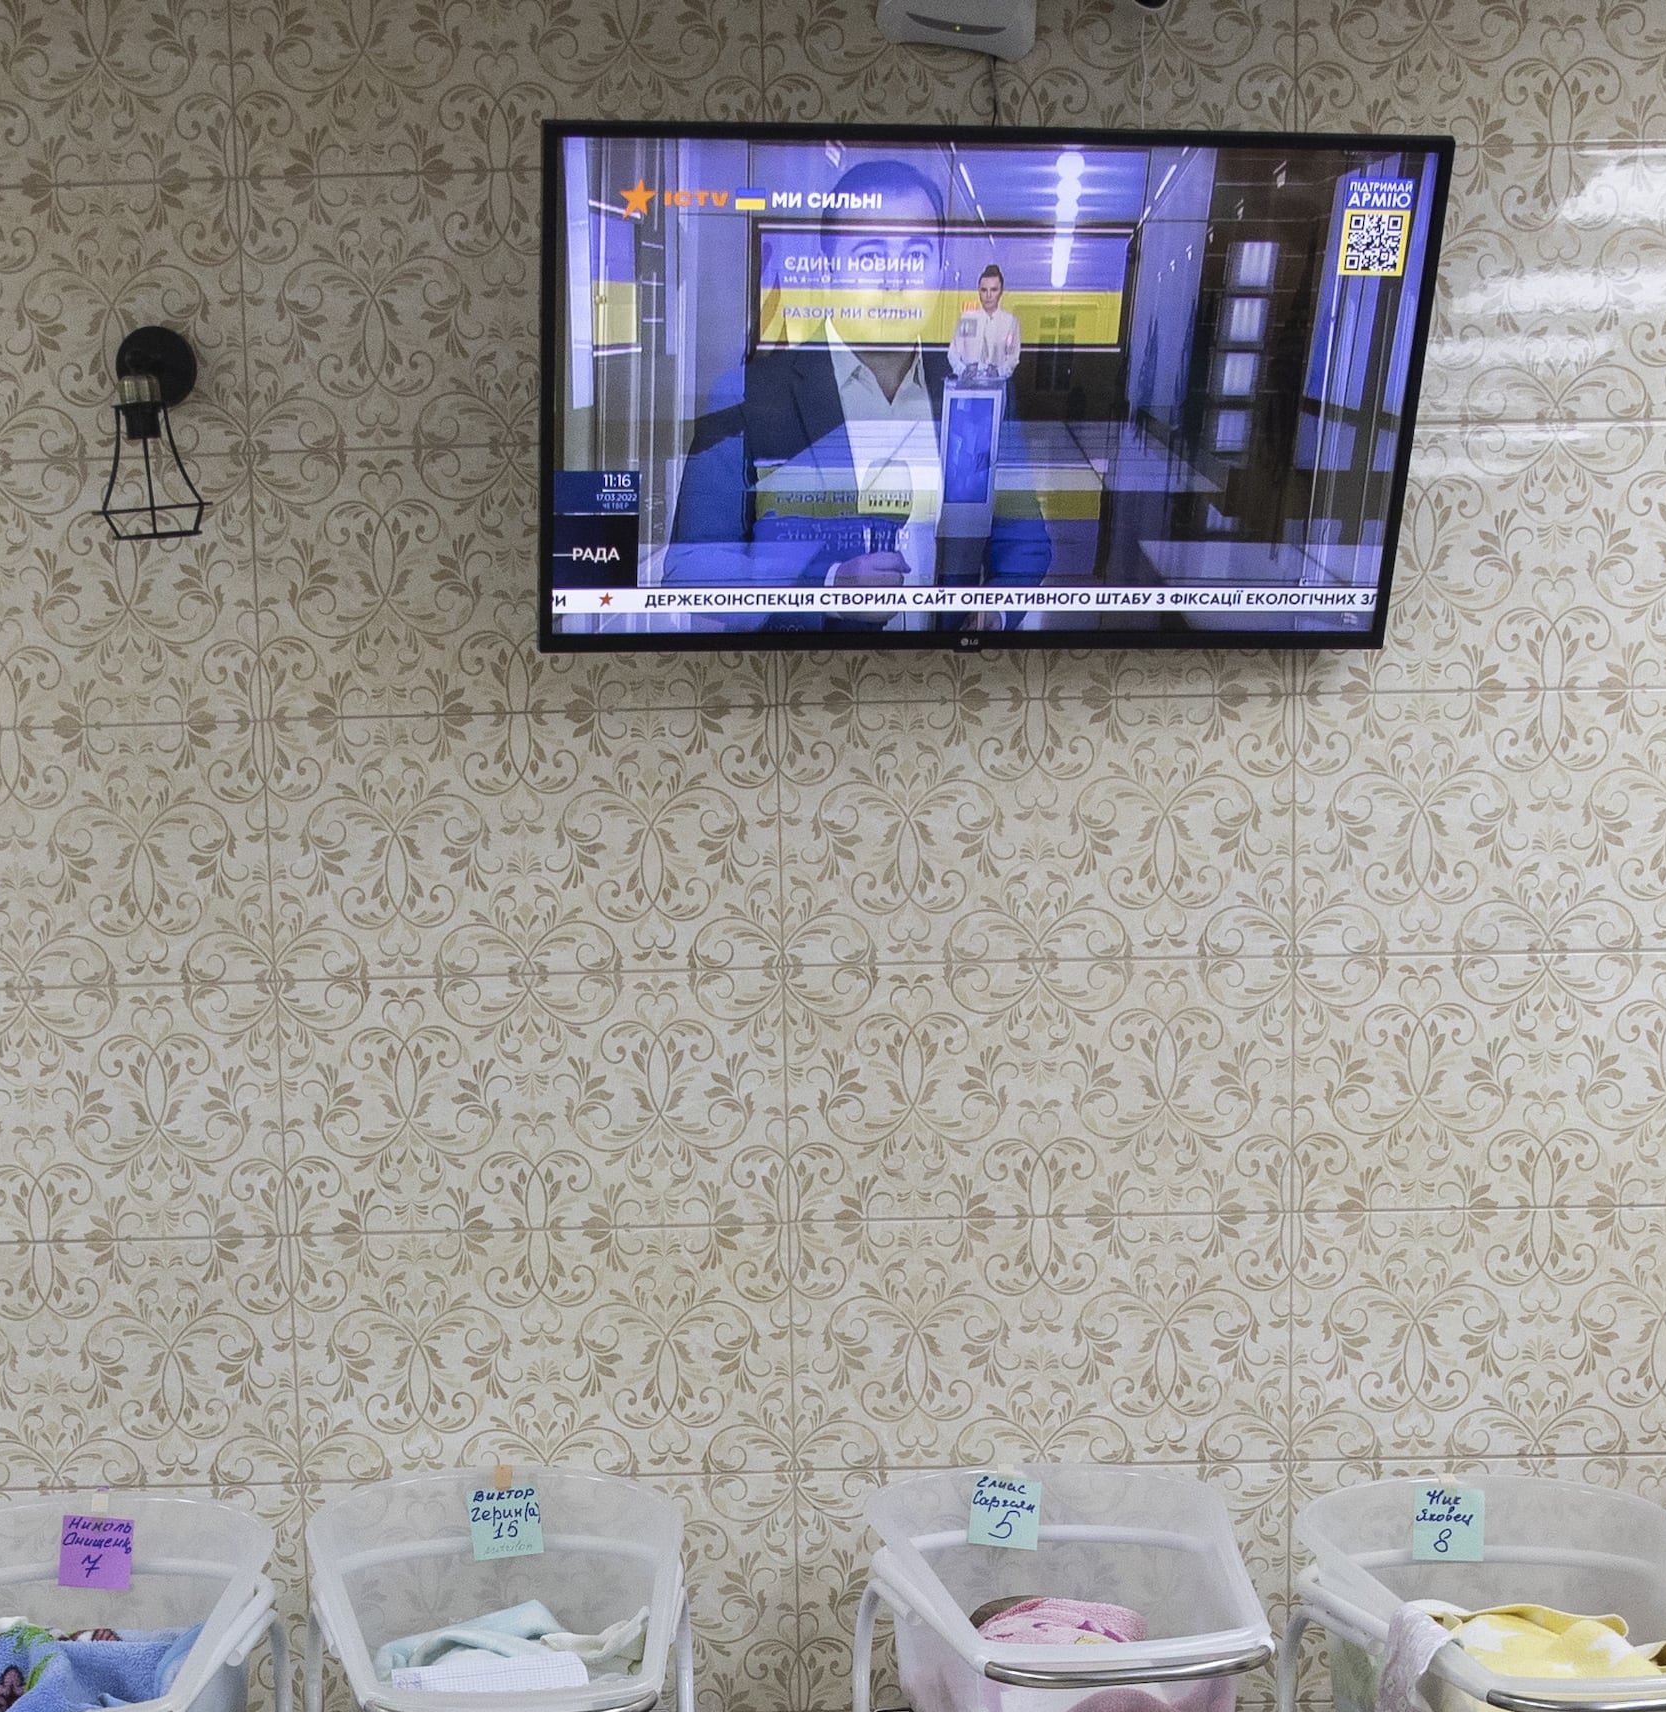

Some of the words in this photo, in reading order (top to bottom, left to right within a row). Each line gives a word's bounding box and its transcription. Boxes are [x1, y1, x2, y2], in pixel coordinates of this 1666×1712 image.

[1350, 181, 1413, 192] ПІДТРИМАЙ
[665, 191, 729, 207] ICTV
[772, 193, 802, 208] МИ
[807, 192, 883, 209] СИЛЬНІ
[1348, 192, 1411, 208] АРМІЮ
[784, 256, 841, 272] ЄДИНІ
[847, 256, 925, 272] НОВИНИ
[783, 307, 834, 318] РАЗОМ
[841, 307, 862, 319] МИ
[868, 307, 923, 319] СИЛЬНІ
[603, 474, 631, 488] 11:16
[602, 502, 629, 510] ЧЕТВЕР
[572, 547, 620, 563] РАДА
[645, 594, 814, 608] ДЕРЖЕКОІНСПЕКЦІЯ
[820, 593, 907, 606] СТВОРИЛА
[912, 589, 956, 606] САЙТ
[961, 593, 1091, 605] ОПЕРАТИВНОГО
[1095, 593, 1152, 605] ШТАБУ
[1156, 593, 1166, 605] З
[1170, 591, 1241, 607] ФІКСАЦІЇ
[1245, 593, 1356, 605] ЕКОЛОГІЧНИХ
[68, 1517, 132, 1533] Николь
[493, 1520, 519, 1539] 15
[988, 1511, 1021, 1539] 5
[1434, 1529, 1452, 1552] 8
[81, 1554, 103, 1578] 7
